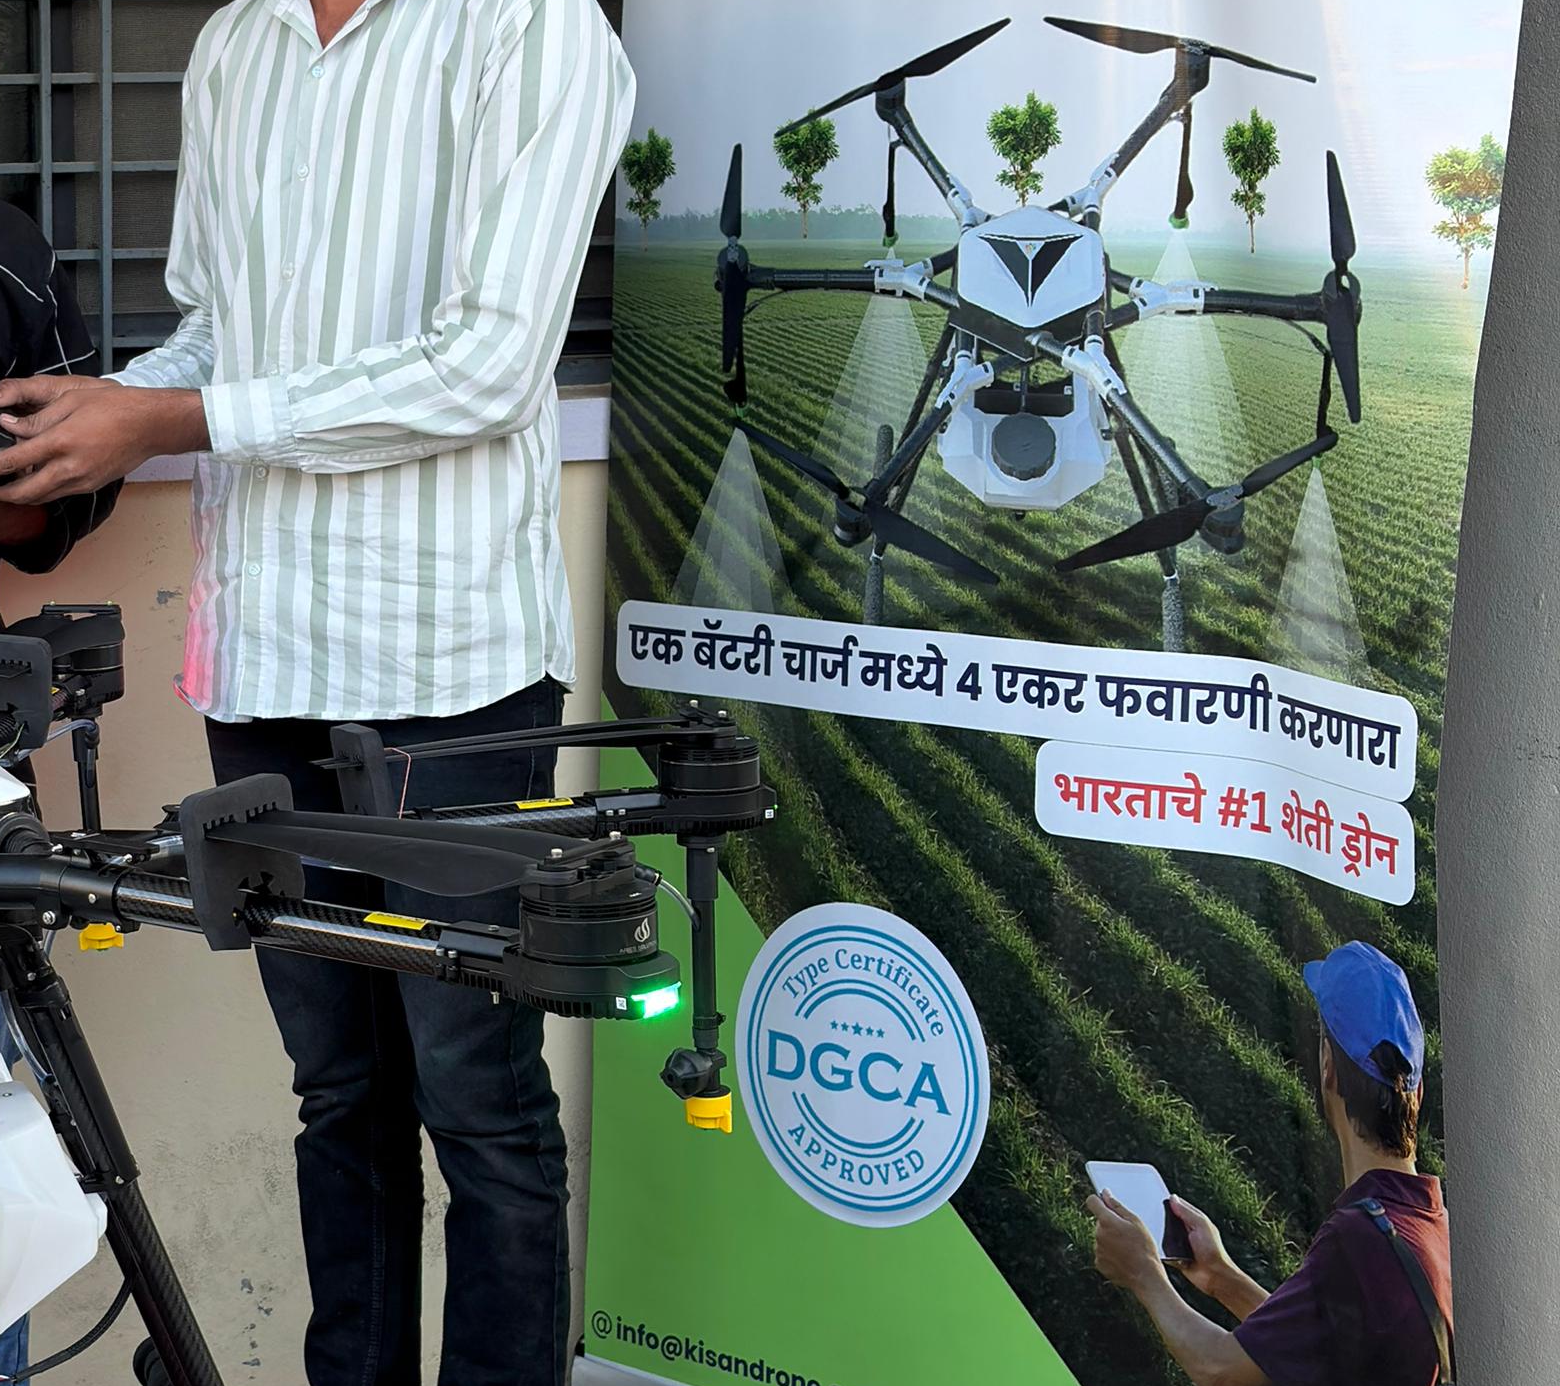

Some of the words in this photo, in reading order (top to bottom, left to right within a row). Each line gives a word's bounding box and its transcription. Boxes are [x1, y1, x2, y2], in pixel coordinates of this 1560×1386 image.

[628, 622, 684, 666] एक
[693, 617, 773, 678] बॅटरी
[781, 624, 860, 689] चार्ज
[860, 642, 950, 699] मध्ये
[956, 663, 983, 702] 4
[992, 664, 1088, 715] एकर
[1096, 668, 1275, 734] फवारणी
[1277, 693, 1403, 771] करणारा
[1053, 771, 1207, 826] भारताचे
[1217, 787, 1274, 834] #1
[1280, 797, 1333, 856] शेती
[1340, 813, 1401, 880] ड्रोन
[782, 957, 829, 1000] Type
[834, 948, 945, 1038] Certificate
[766, 1028, 953, 1117] DGCA
[788, 1122, 925, 1186] APPROVED
